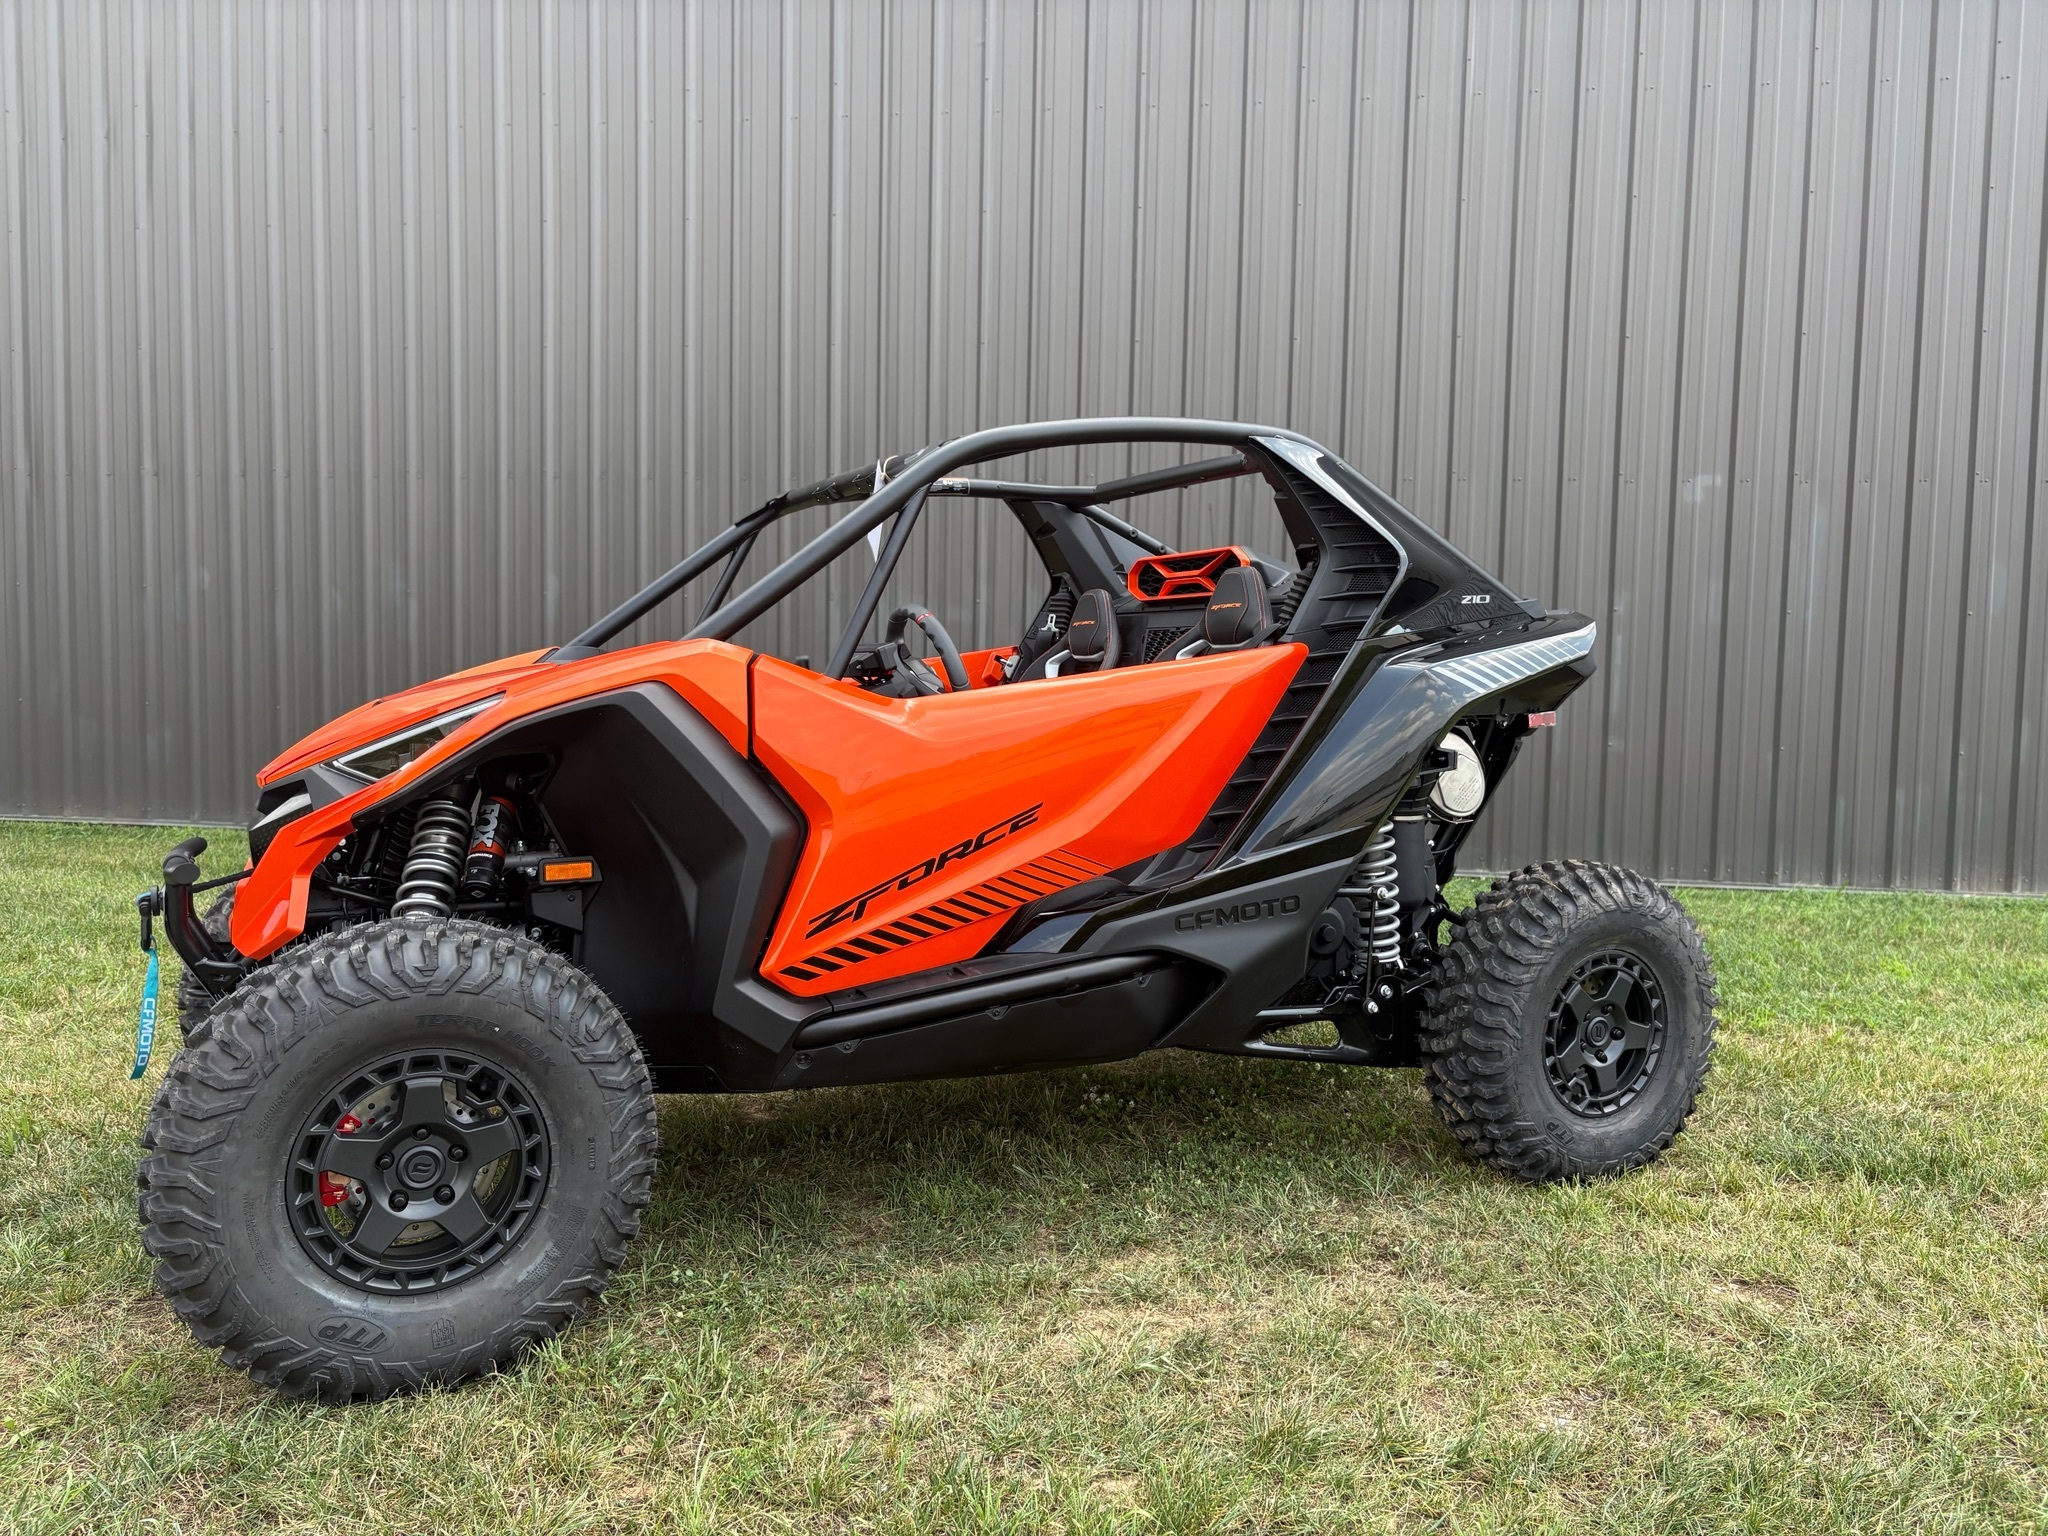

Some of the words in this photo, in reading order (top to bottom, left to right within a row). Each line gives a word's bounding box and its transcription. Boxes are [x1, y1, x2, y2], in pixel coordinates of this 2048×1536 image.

[472, 803, 501, 848] FOX
[805, 801, 1044, 940] ZFORCE
[1174, 895, 1300, 934] CFMOTO
[137, 997, 156, 1067] CFMOTO
[1546, 1121, 1575, 1147] ITP
[317, 1322, 388, 1350] ITP
